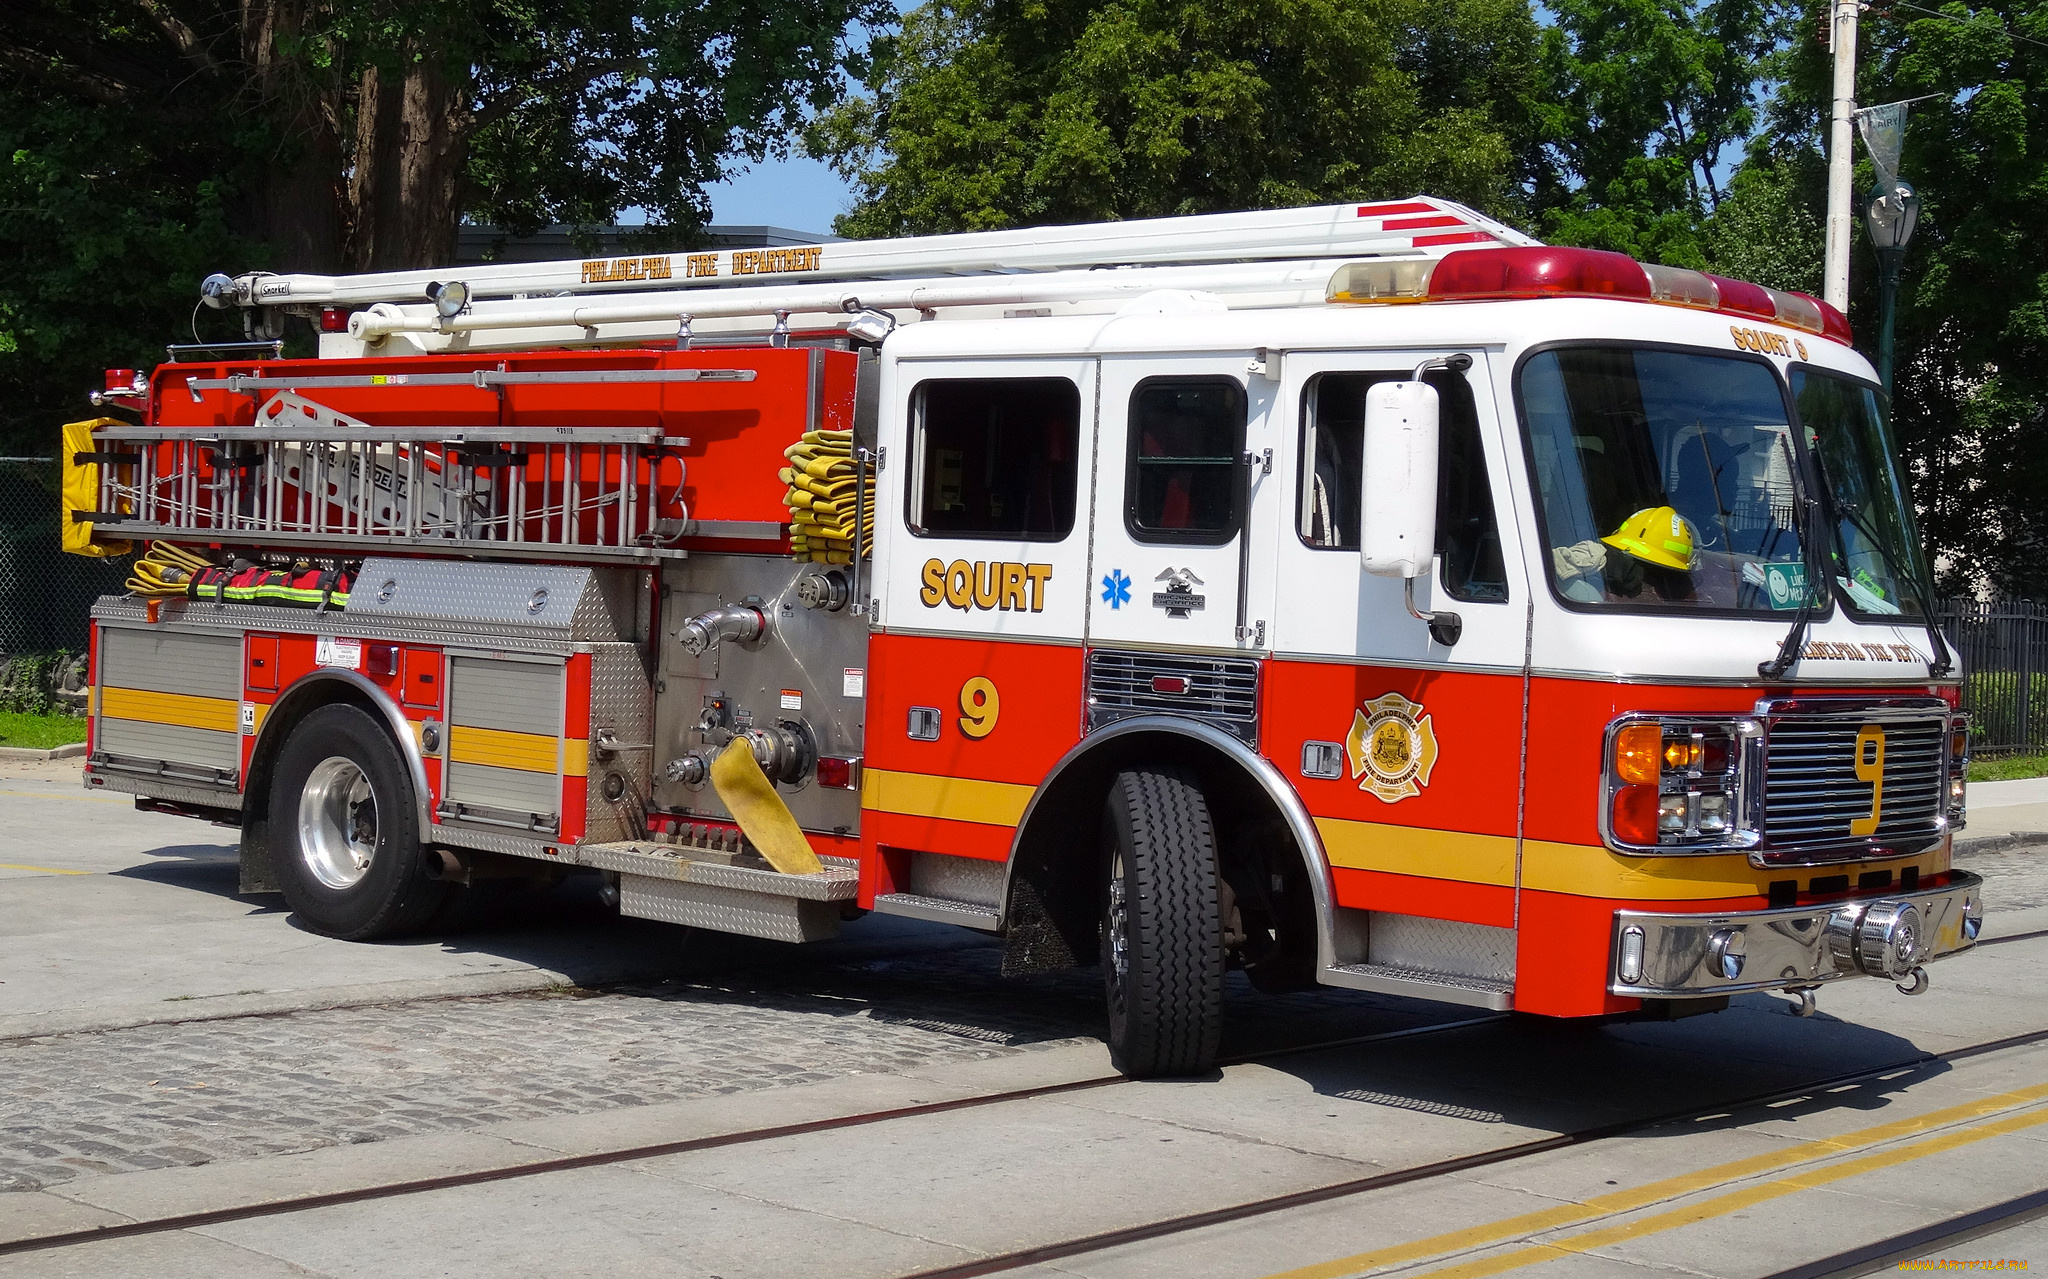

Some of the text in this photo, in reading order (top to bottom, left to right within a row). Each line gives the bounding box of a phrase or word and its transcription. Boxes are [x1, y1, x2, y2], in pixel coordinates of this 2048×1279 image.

[581, 247, 822, 283] PHILADELPHIA FIRE DEPARTMENT
[1730, 326, 1808, 362] SQURT 9
[919, 557, 1053, 613] SQURT
[1776, 641, 1866, 661] ILADELPHIA
[957, 676, 1000, 741] 9
[1370, 710, 1416, 729] PHILADELPHIA
[1363, 760, 1419, 784] FIRE DEPARTMENT
[1850, 724, 1885, 836] 9
